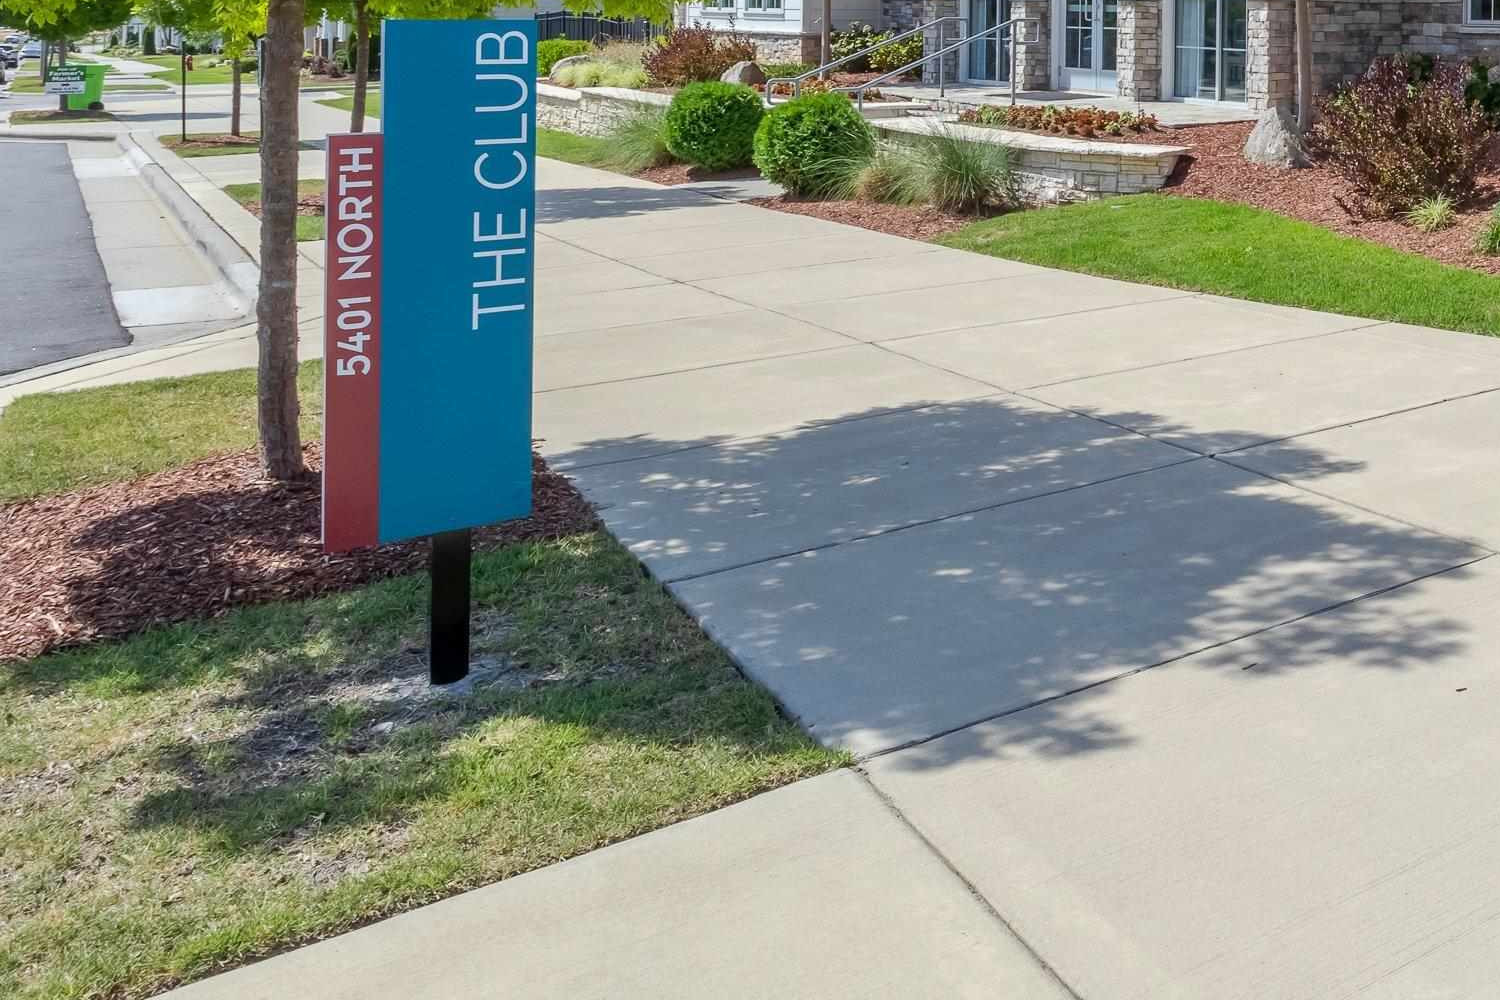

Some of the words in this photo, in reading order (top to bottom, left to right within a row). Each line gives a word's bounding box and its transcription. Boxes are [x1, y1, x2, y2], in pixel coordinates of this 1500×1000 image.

[474, 30, 529, 190] CLUB
[336, 147, 374, 281] NORTH
[471, 208, 526, 331] THE
[336, 296, 372, 377] 5401
